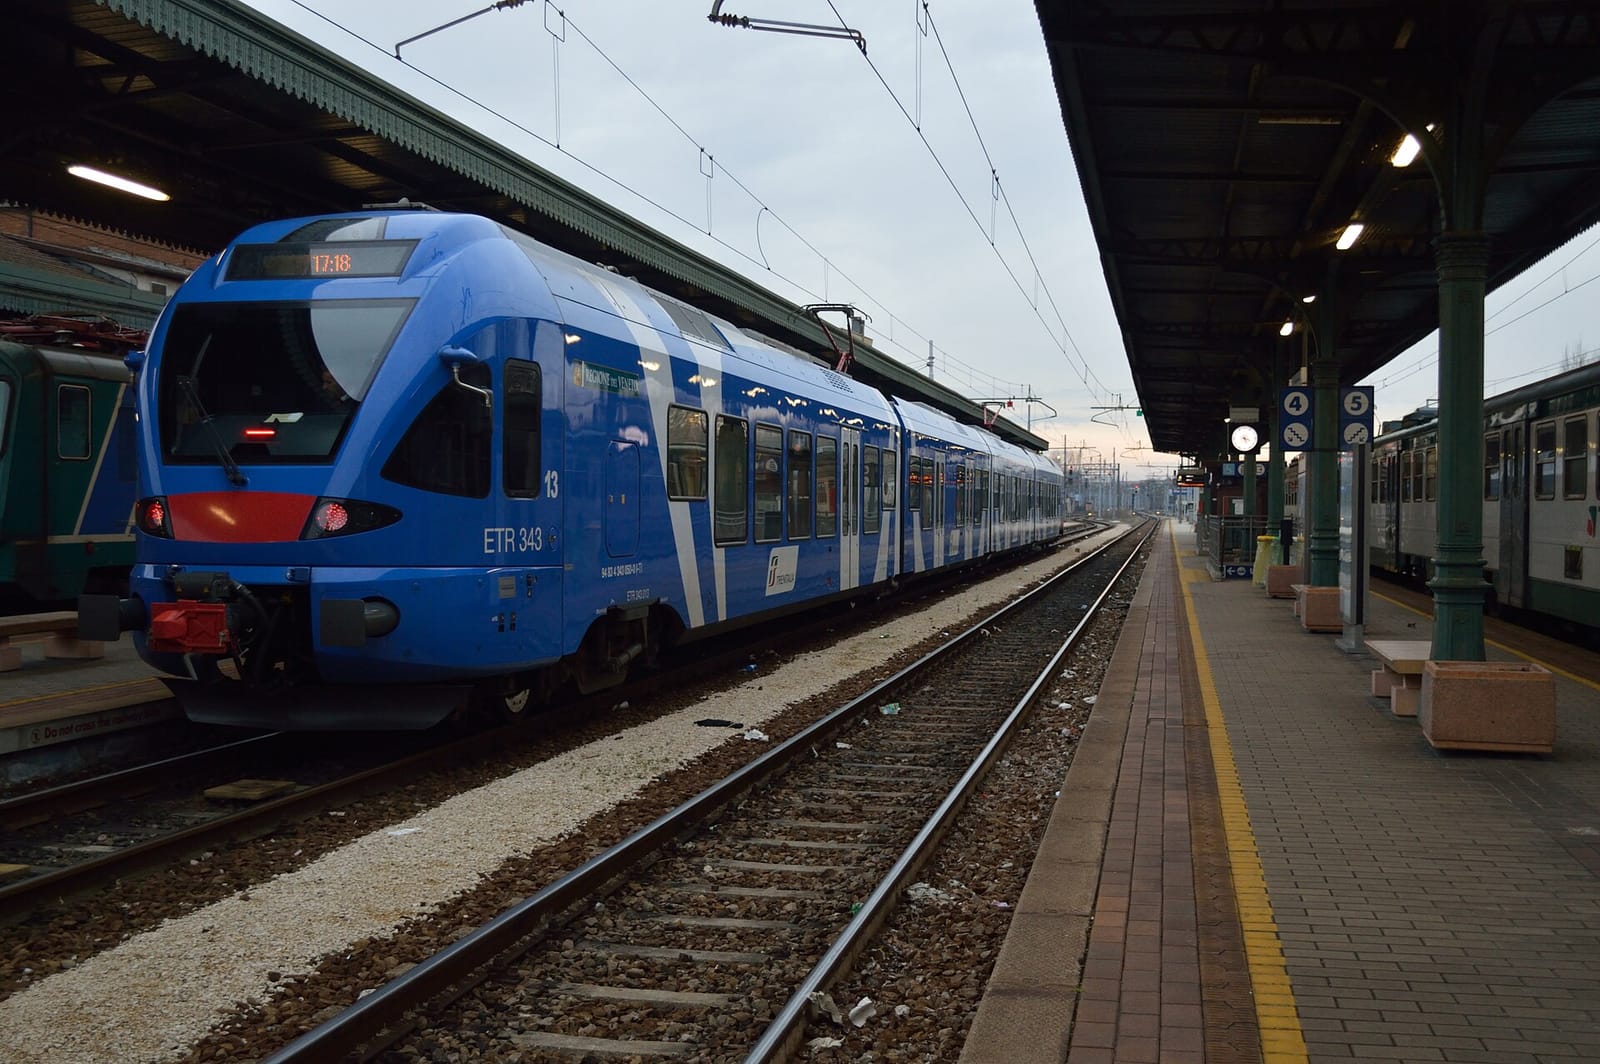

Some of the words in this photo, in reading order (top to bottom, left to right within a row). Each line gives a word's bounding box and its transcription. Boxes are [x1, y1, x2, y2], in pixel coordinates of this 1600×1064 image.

[312, 254, 352, 273] 17:18
[585, 368, 610, 386] REGIONE
[1289, 396, 1302, 411] 4
[1350, 396, 1362, 411] 5
[544, 470, 559, 499] 13
[484, 527, 516, 554] ETR
[519, 526, 542, 552] 343
[44, 727, 57, 738] Do
[59, 724, 74, 735] not
[75, 720, 97, 732] cross
